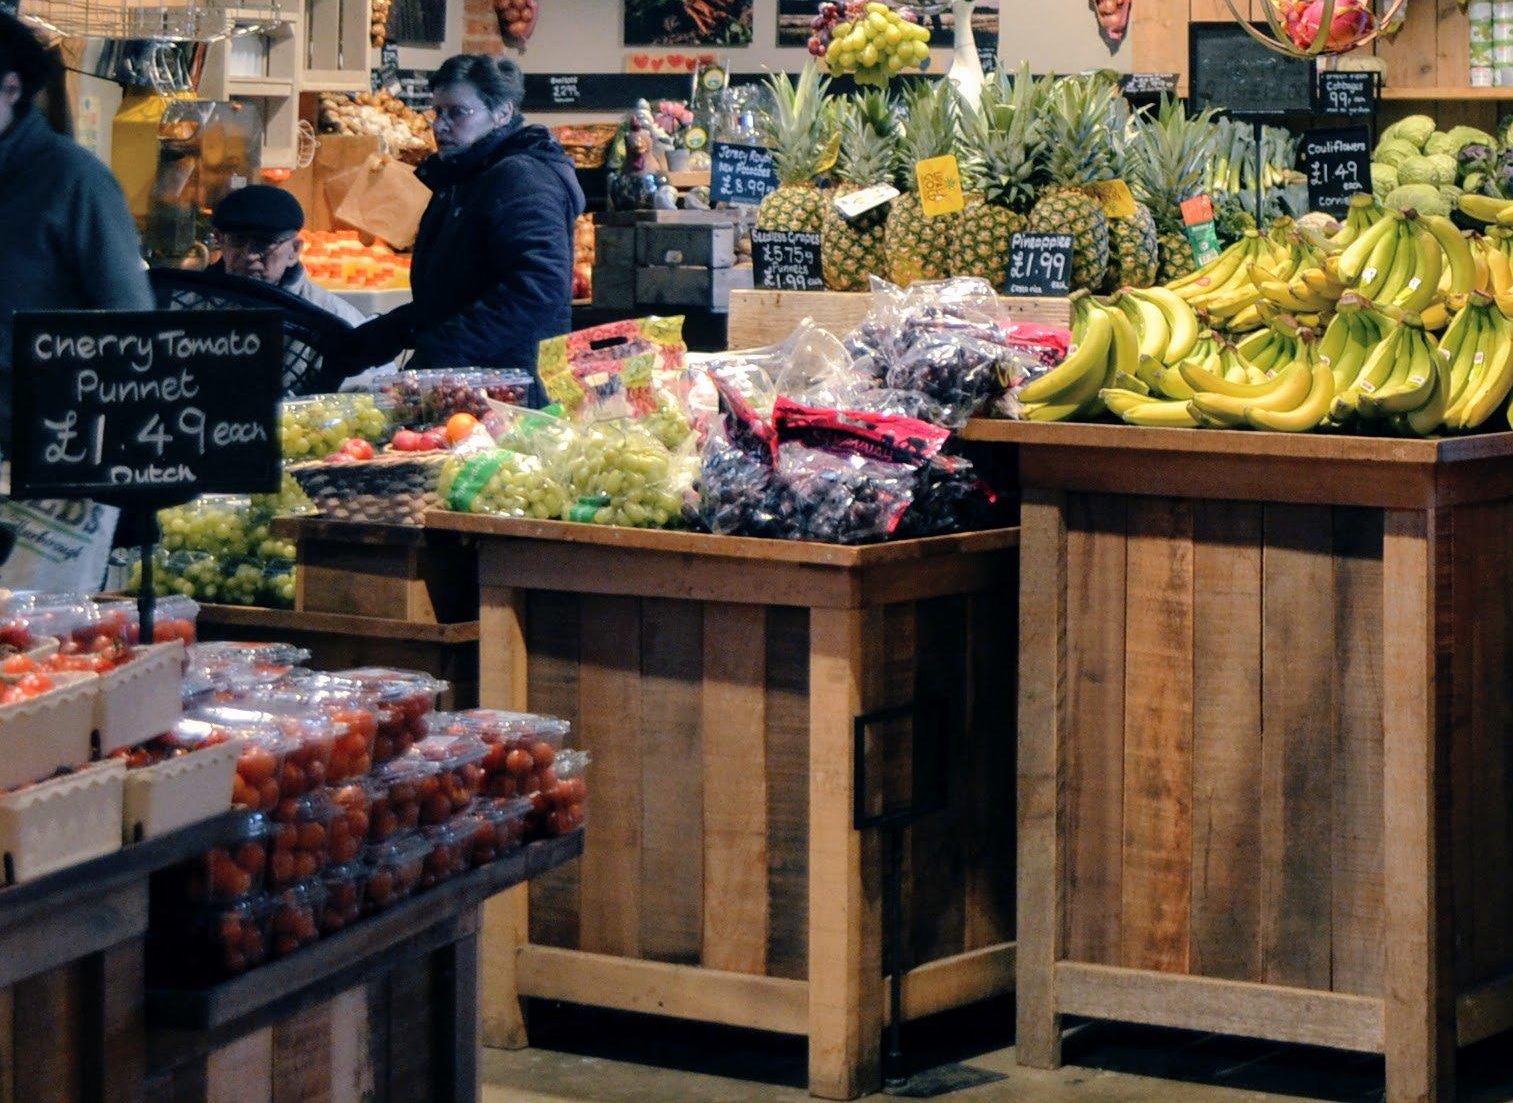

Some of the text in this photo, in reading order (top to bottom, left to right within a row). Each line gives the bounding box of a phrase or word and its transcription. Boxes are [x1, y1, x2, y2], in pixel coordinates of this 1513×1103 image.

[1307, 140, 1366, 155] Cauliflowers
[1310, 160, 1357, 185] £1.49
[720, 174, 765, 196] £8.99
[751, 229, 820, 246] Seedless Grapes
[1011, 233, 1071, 250] Pineapples
[1010, 250, 1065, 280] £1.99
[763, 266, 807, 290] £1.99
[35, 330, 261, 372] Cherry Tomato
[76, 368, 200, 403] Punnet
[43, 407, 268, 466] £1.49 each
[110, 462, 197, 485] Dutch
